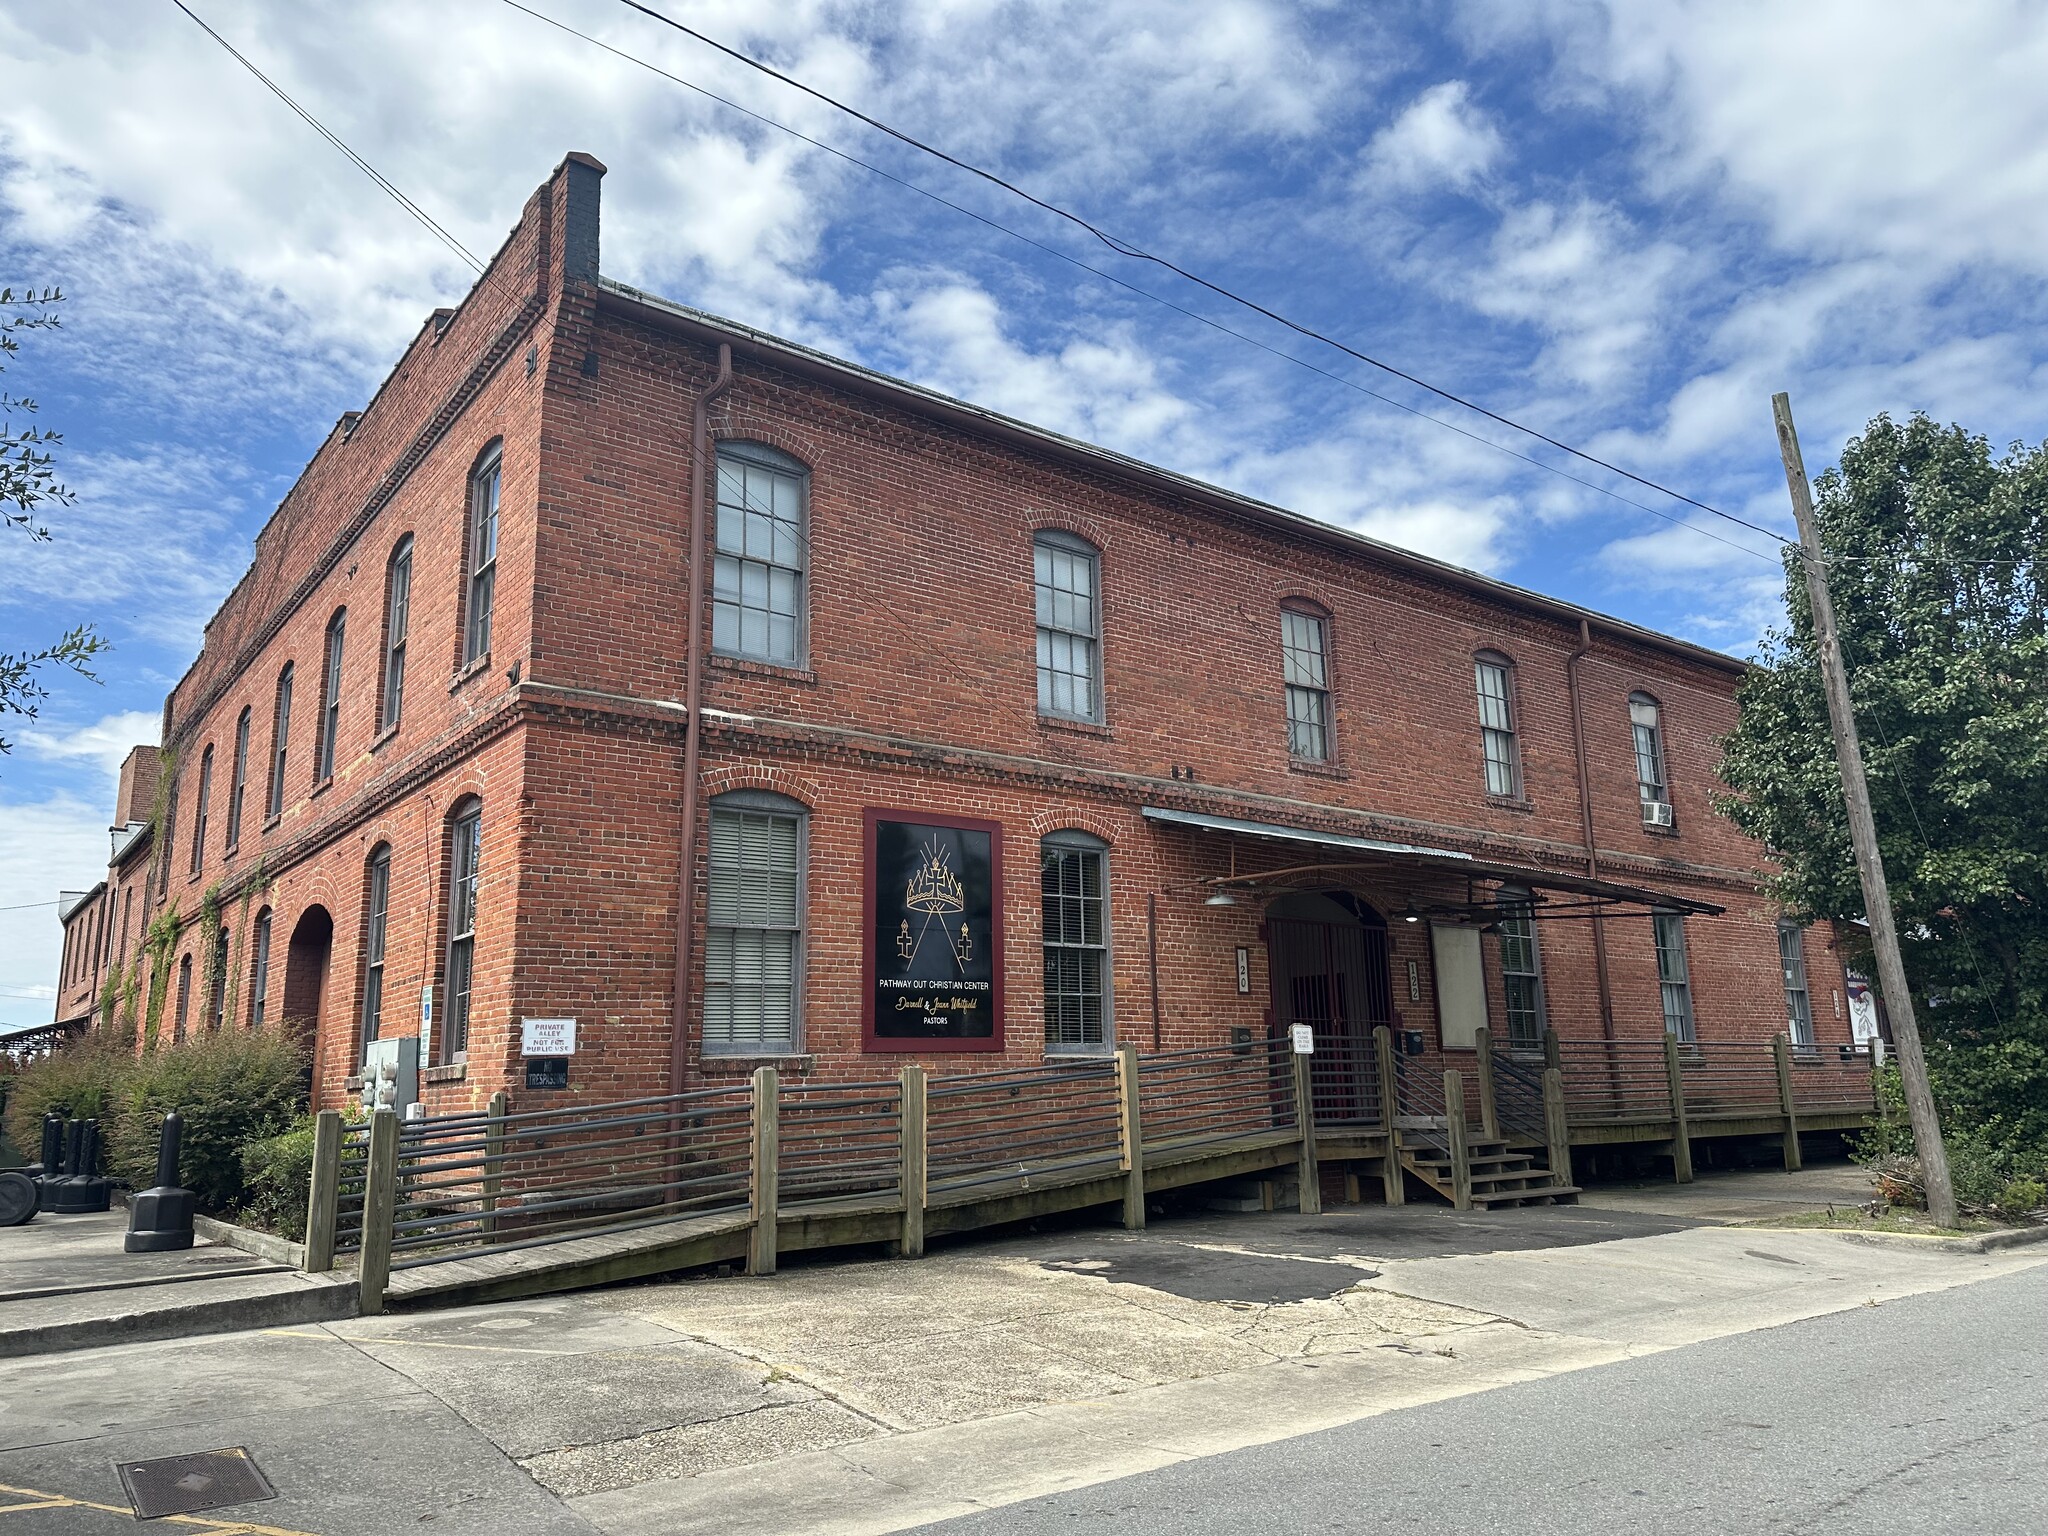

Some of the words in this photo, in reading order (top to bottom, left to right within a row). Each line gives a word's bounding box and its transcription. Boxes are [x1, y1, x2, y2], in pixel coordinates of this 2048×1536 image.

[1239, 950, 1247, 988] 120
[879, 979, 912, 989] PATHWAY
[913, 980, 927, 989] OUT
[928, 980, 963, 990] CHRISTIAN
[964, 981, 989, 990] CENTER
[1410, 963, 1418, 999] 122
[895, 996, 924, 1011] Darnell
[923, 1000, 930, 1011] &
[950, 996, 978, 1014] Whitfield
[923, 1017, 948, 1025] PASTORS
[544, 1061, 553, 1072] NO
[529, 1073, 566, 1085] TRESPASSING
